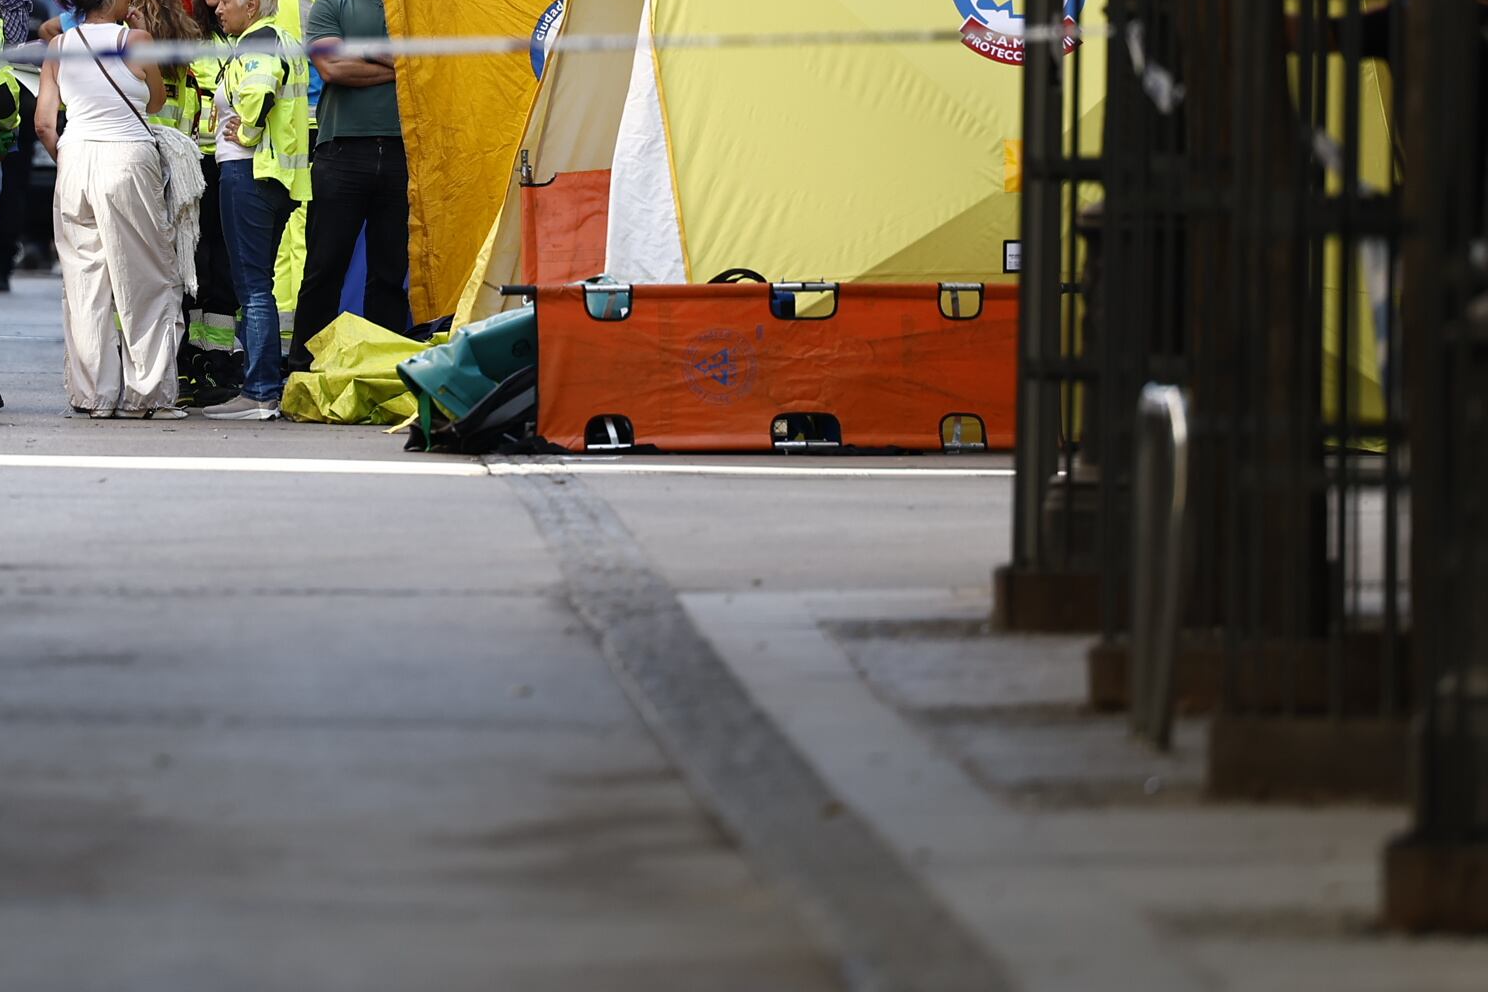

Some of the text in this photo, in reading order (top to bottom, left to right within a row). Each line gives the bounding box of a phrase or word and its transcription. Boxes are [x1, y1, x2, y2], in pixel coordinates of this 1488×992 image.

[536, 0, 564, 41] ciudad
[966, 32, 1024, 62] PROTECC
[984, 31, 1025, 49] S.A.M
